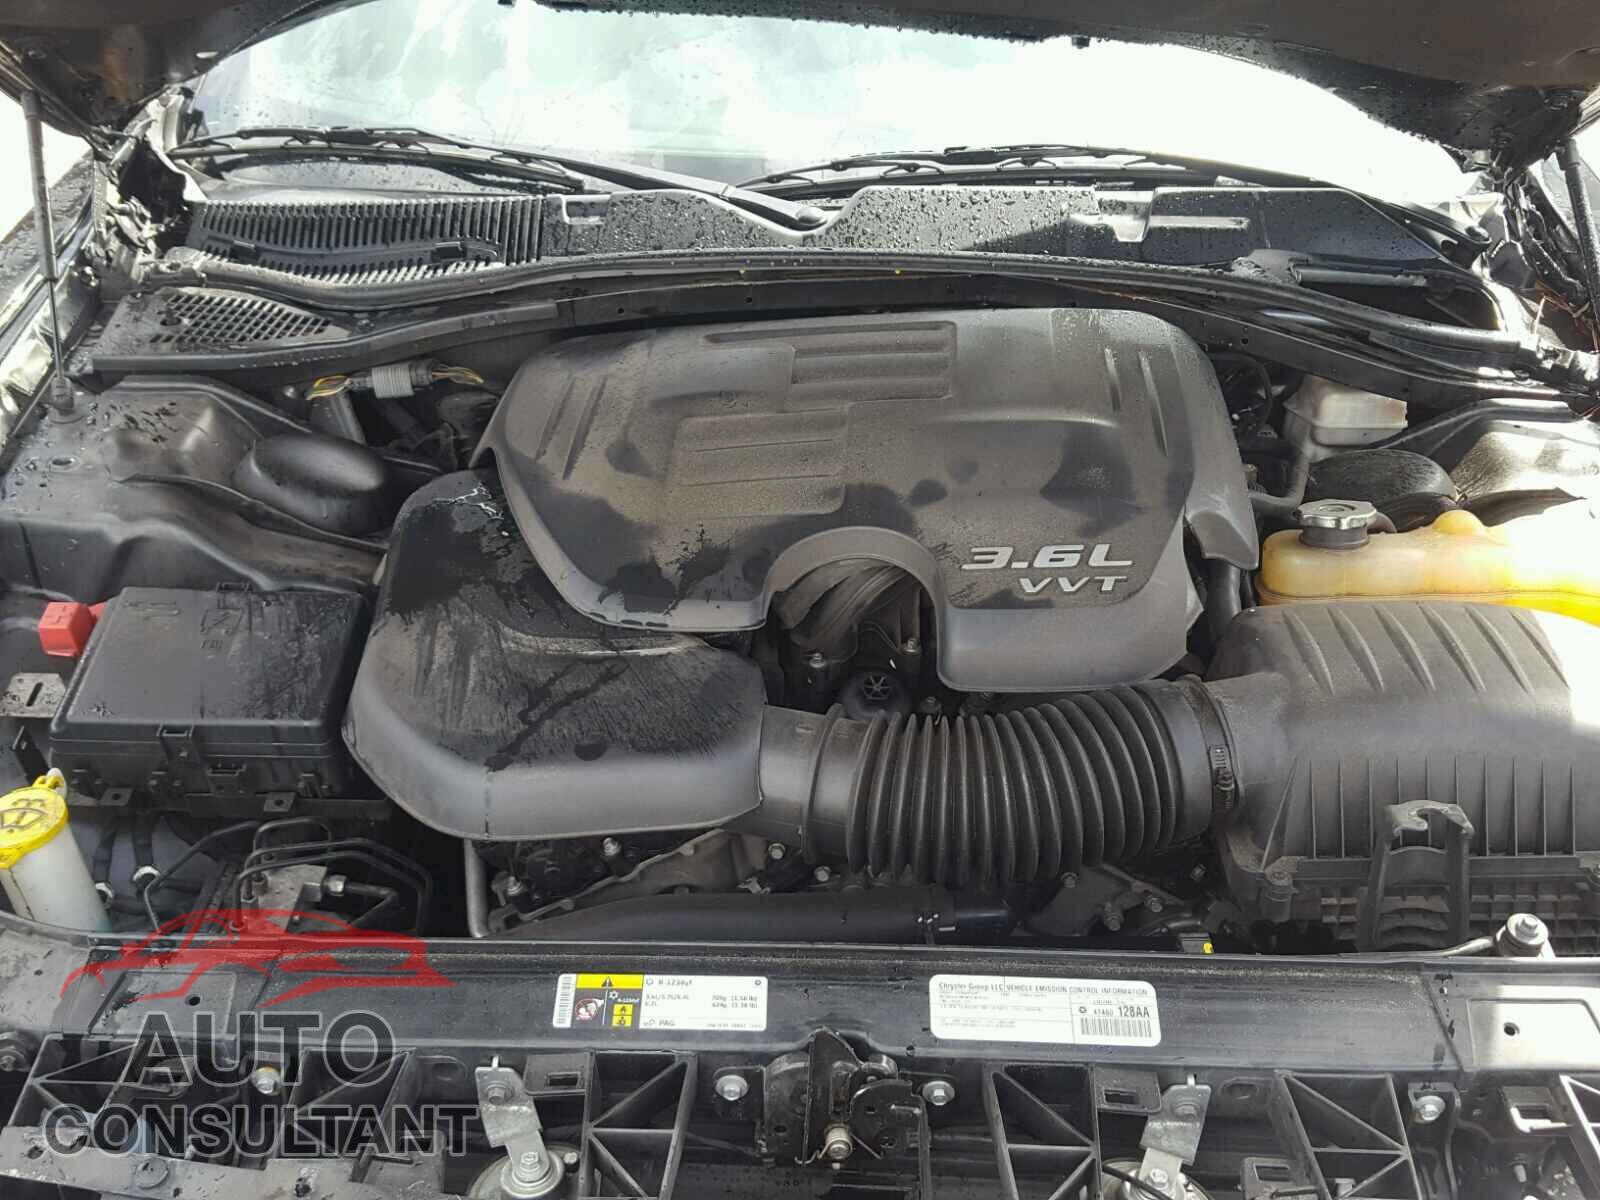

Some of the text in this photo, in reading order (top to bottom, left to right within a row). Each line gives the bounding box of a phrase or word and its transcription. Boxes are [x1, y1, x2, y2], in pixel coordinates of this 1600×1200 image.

[961, 543, 1133, 570] 3.6L
[1019, 576, 1127, 593] VVT
[1069, 986, 1099, 994] CONTROL
[1101, 987, 1148, 995] INFORMATION
[1118, 1006, 1150, 1018] 128AA
